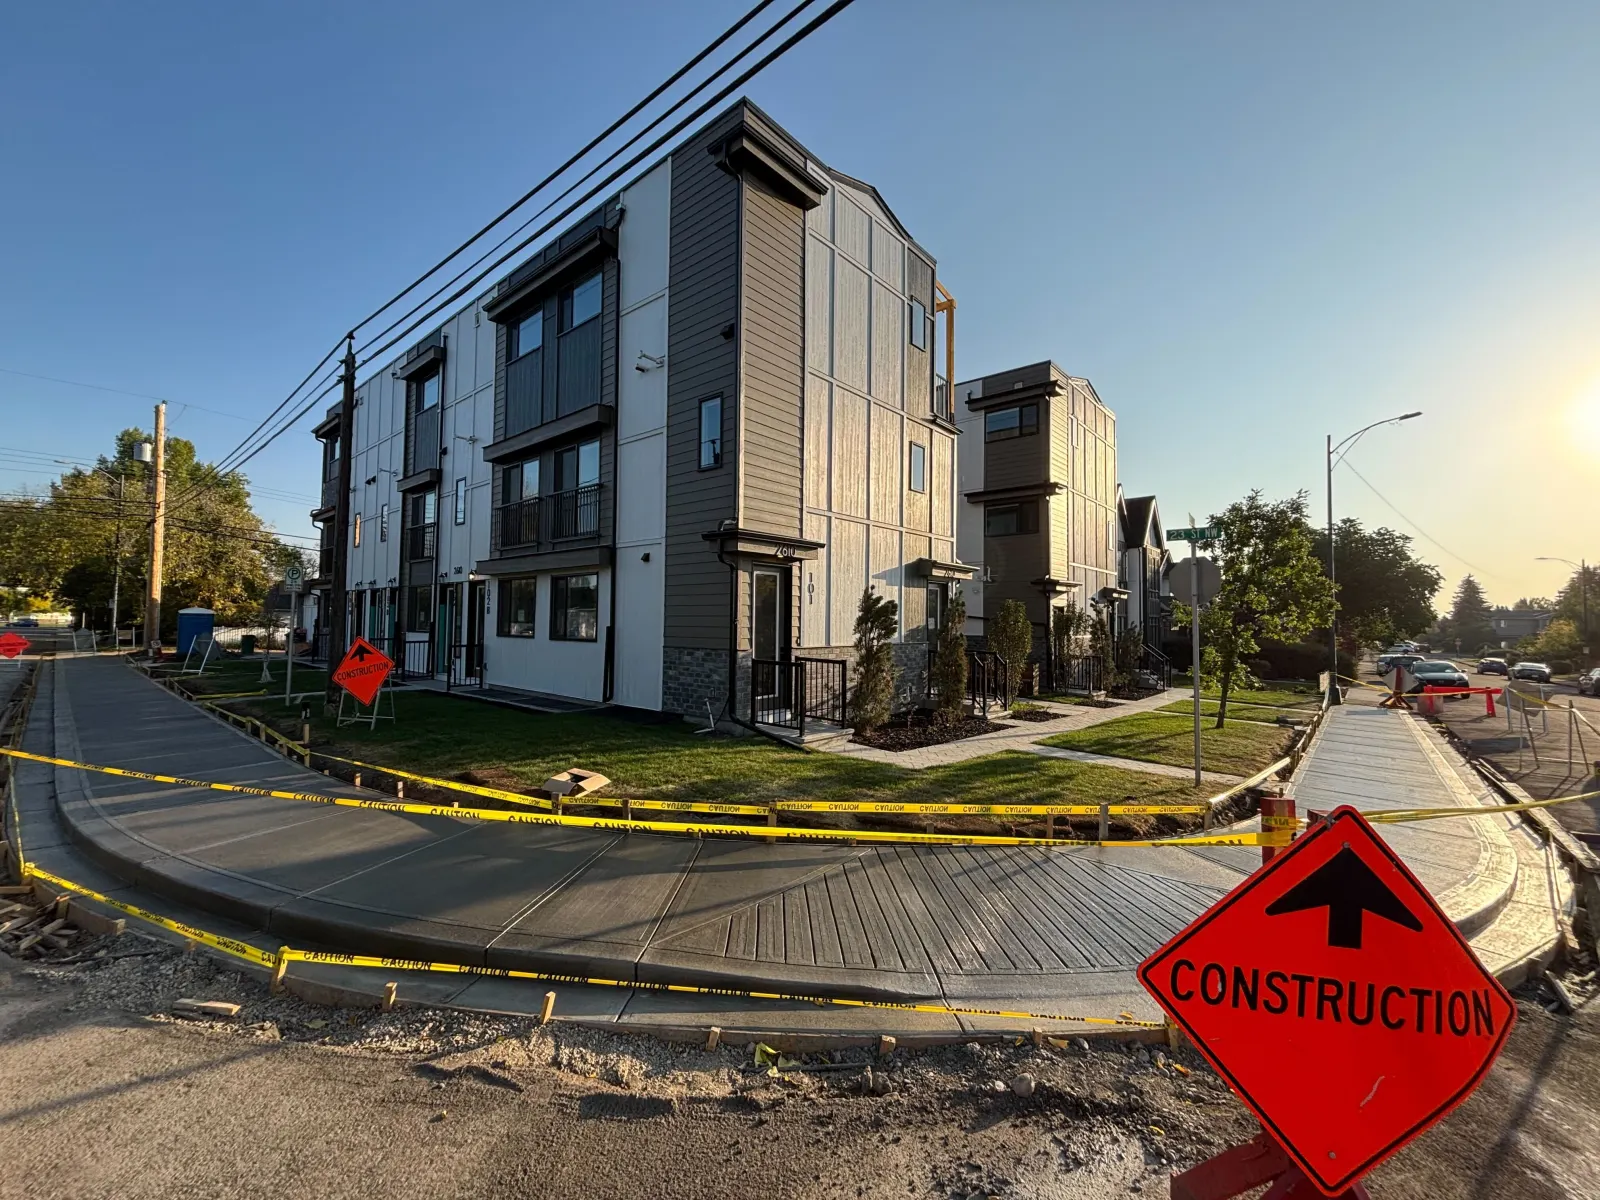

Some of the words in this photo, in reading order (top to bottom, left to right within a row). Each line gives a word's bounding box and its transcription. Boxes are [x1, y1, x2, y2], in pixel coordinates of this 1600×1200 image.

[1170, 530, 1185, 540] 23
[1191, 528, 1200, 539] ST
[1205, 527, 1217, 538] NW
[336, 661, 389, 681] CONSTRUCTION
[359, 801, 405, 812] CAUTION
[216, 936, 248, 956] CAUTION
[303, 951, 354, 964] CAUTION
[381, 957, 431, 970] CAUTION
[1170, 958, 1494, 1037] CONSTRUCTION
